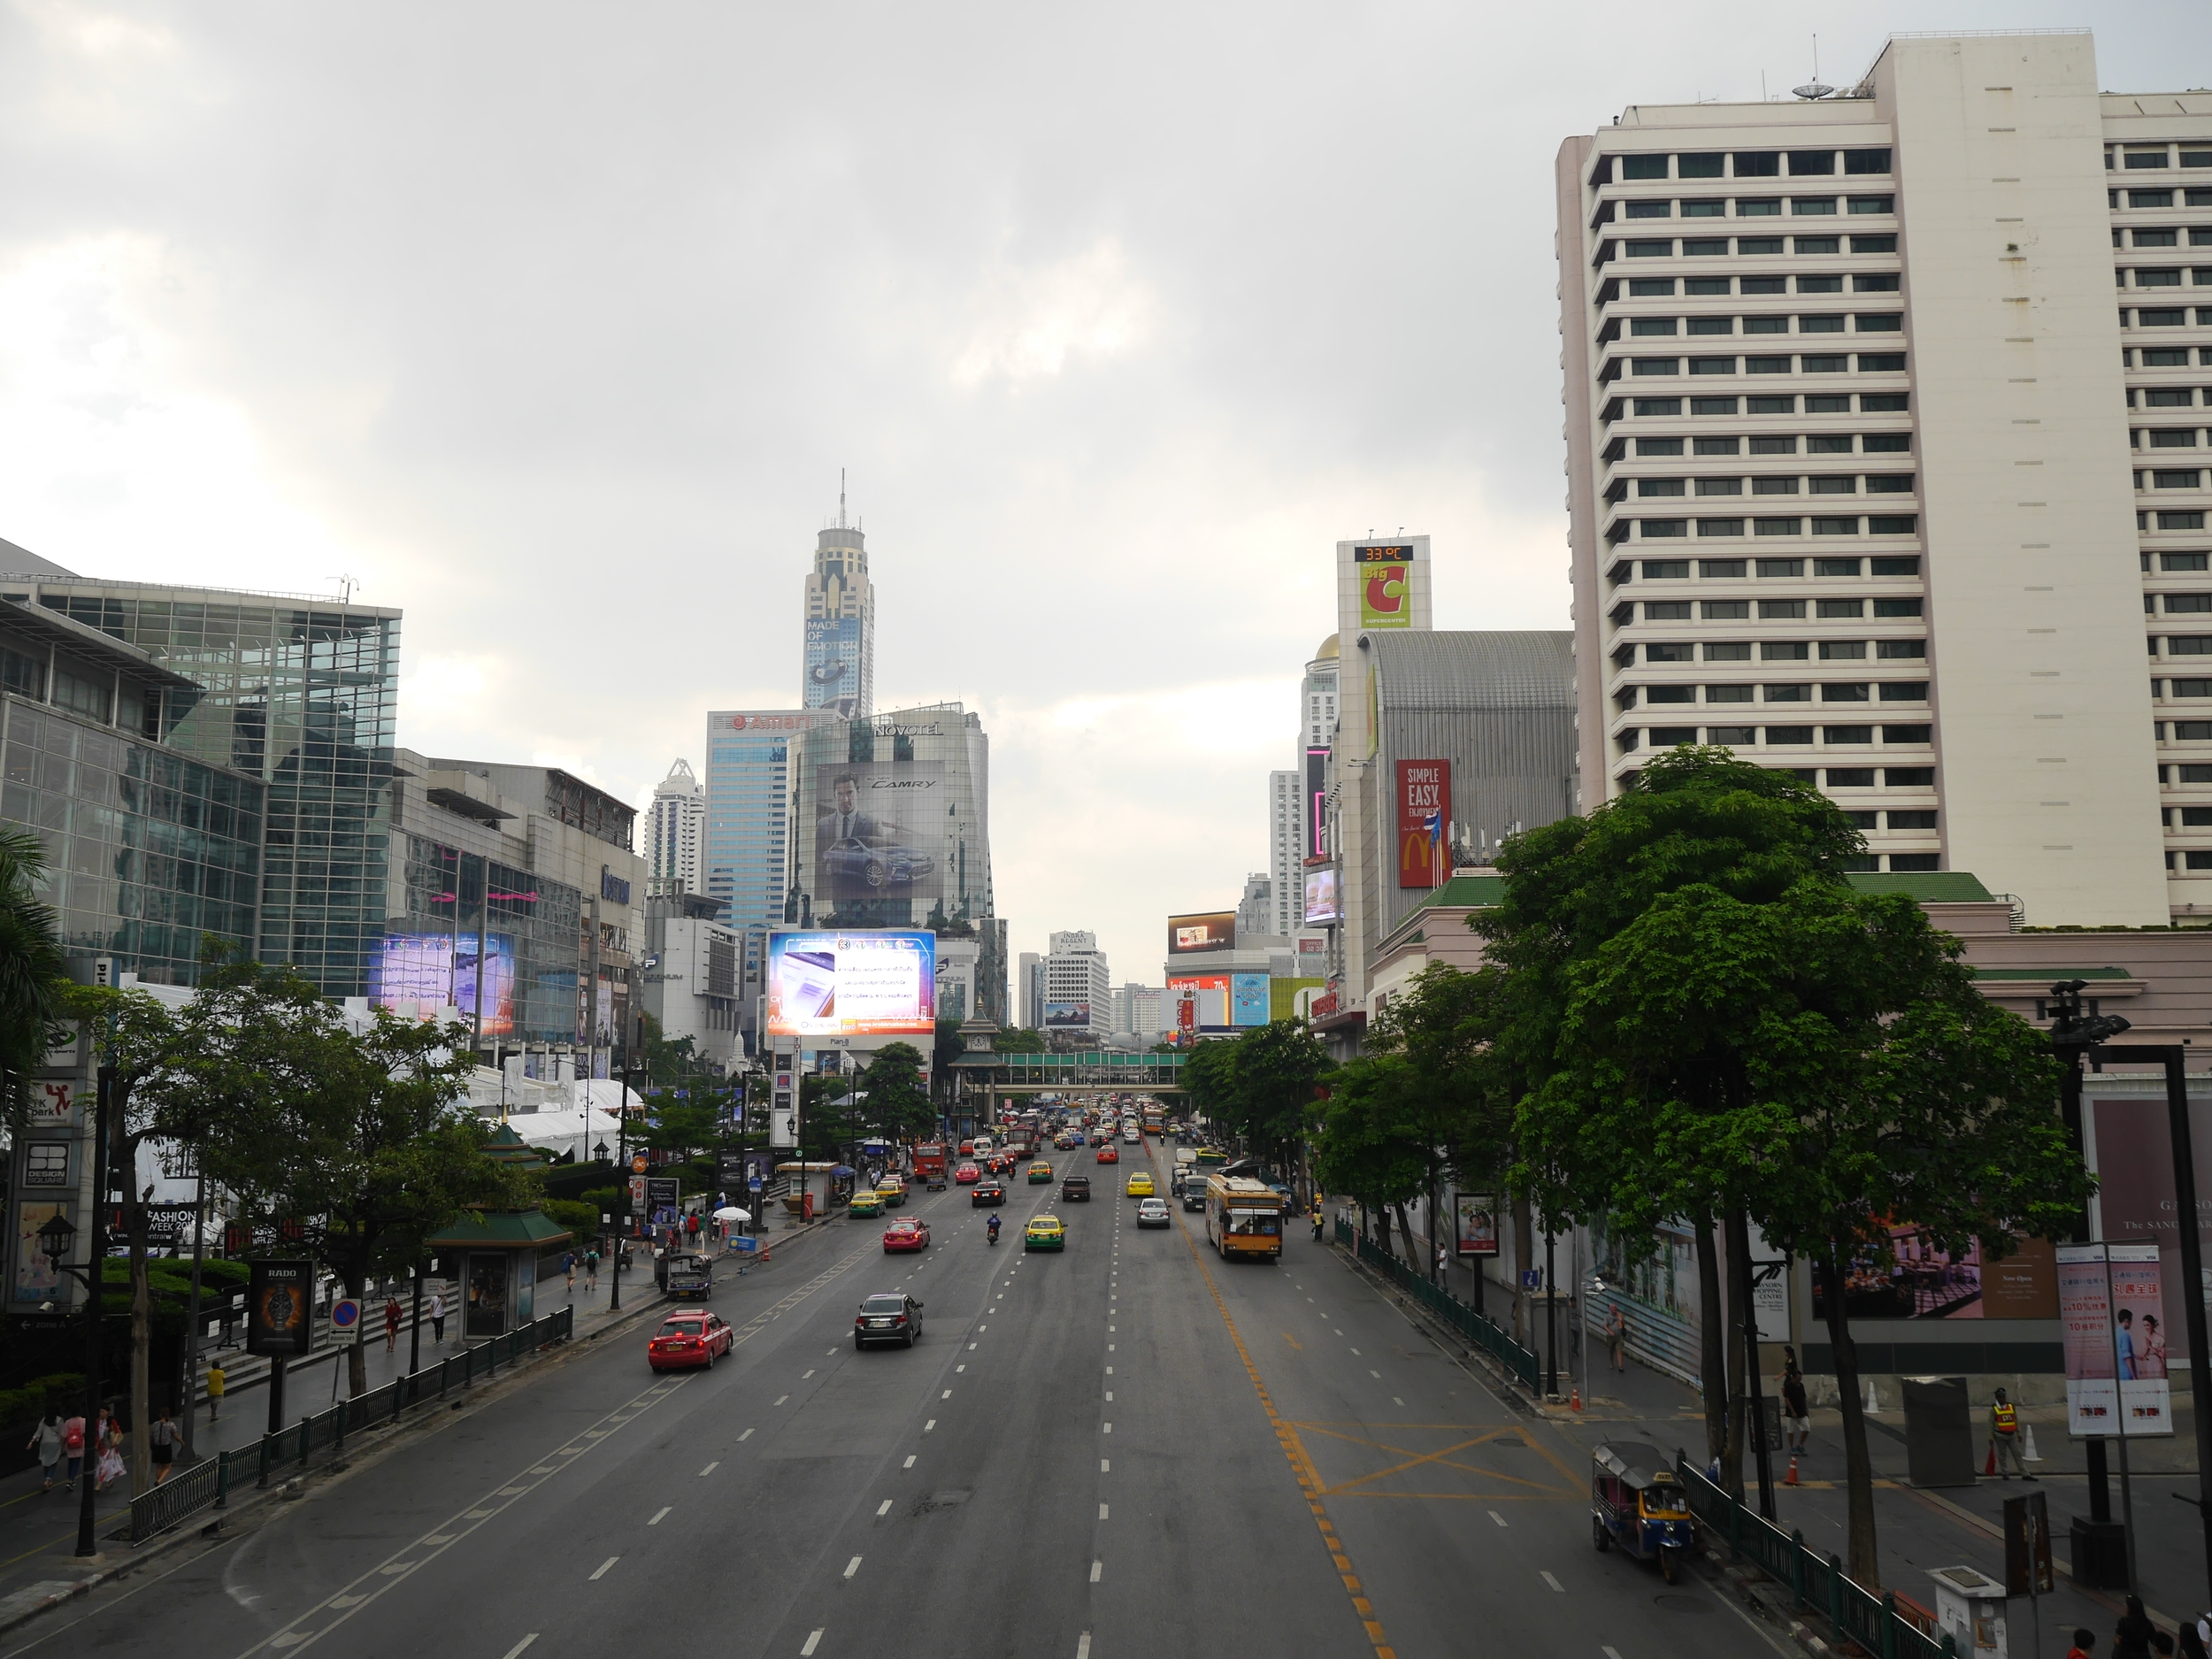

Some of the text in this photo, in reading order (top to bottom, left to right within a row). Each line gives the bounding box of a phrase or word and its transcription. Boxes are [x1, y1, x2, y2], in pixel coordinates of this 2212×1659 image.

[1366, 548, 1383, 560] 33
[1363, 567, 1388, 583] Big
[807, 621, 840, 631] MADE
[807, 631, 824, 641] OF
[807, 641, 858, 651] EMOTION
[750, 714, 810, 730] Amari
[873, 722, 944, 737] NOVOTEL
[1407, 768, 1440, 783] SIMPLE
[871, 780, 937, 789] CAMRY
[1409, 808, 1439, 818] ENJOYMEN
[32, 1108, 55, 1118] park
[2124, 1221, 2135, 1230] The
[2114, 1283, 2158, 1294] 礼遇全球
